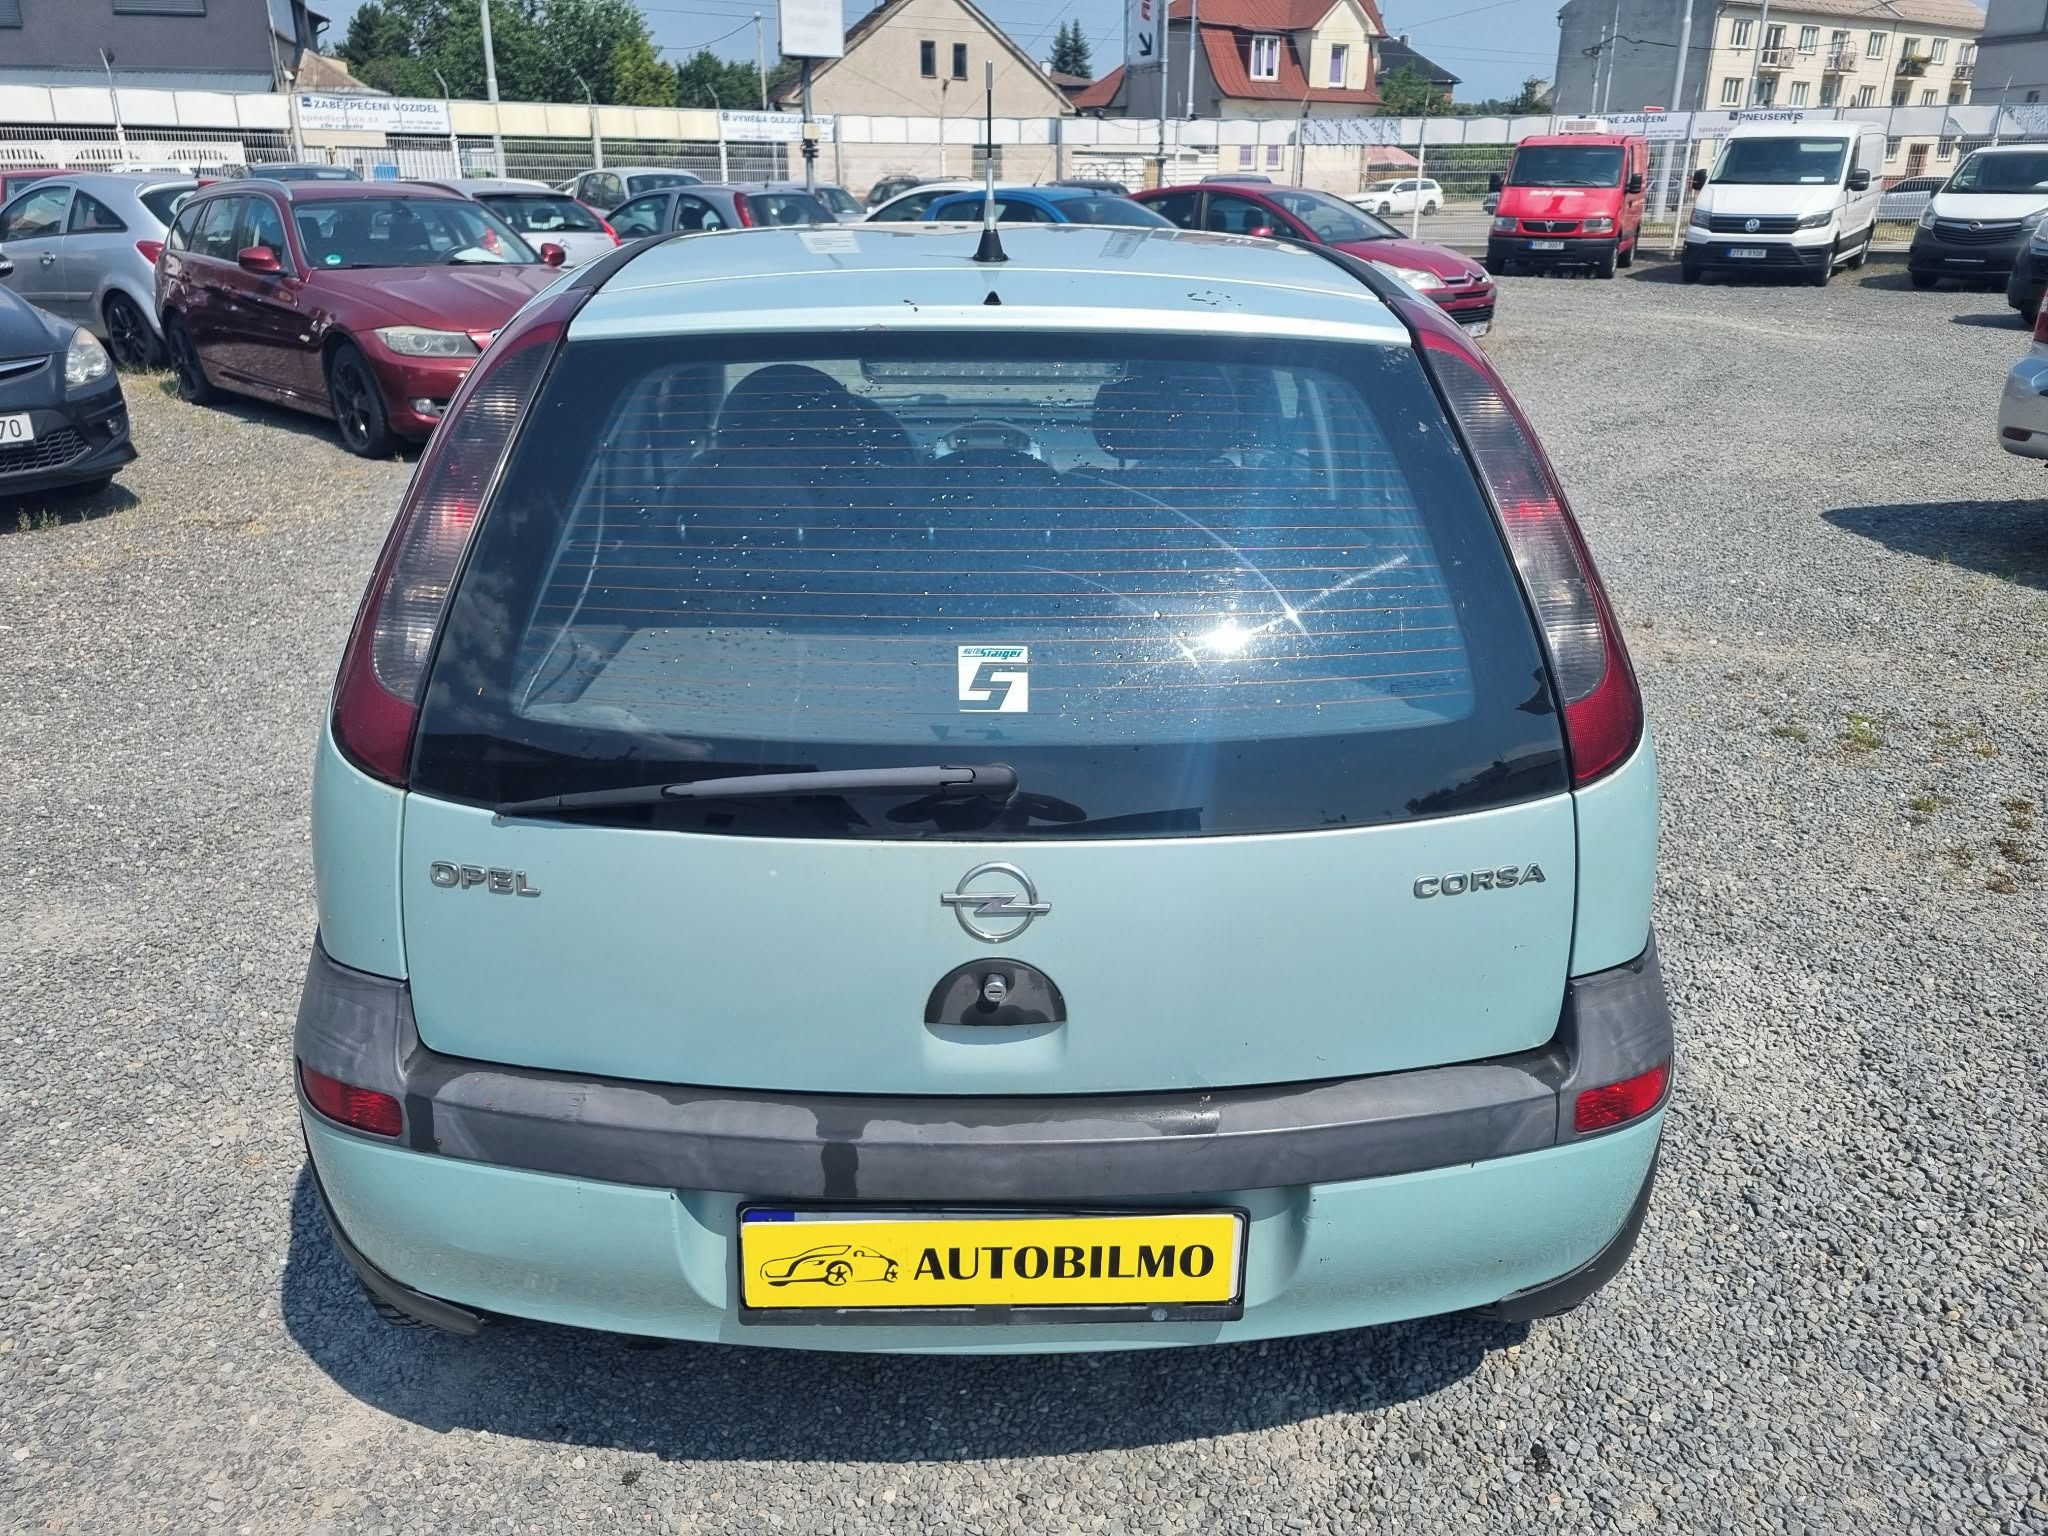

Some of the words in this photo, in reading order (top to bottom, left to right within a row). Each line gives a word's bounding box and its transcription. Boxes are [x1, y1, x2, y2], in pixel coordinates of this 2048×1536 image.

[393, 103, 439, 113] VOZIDEL
[1739, 112, 1804, 121] PNEUSERVIS
[979, 648, 1025, 660] Staiger
[430, 860, 541, 898] OPEL
[1413, 862, 1546, 899] CORSA
[913, 1244, 1214, 1281] AUTOBILMO
